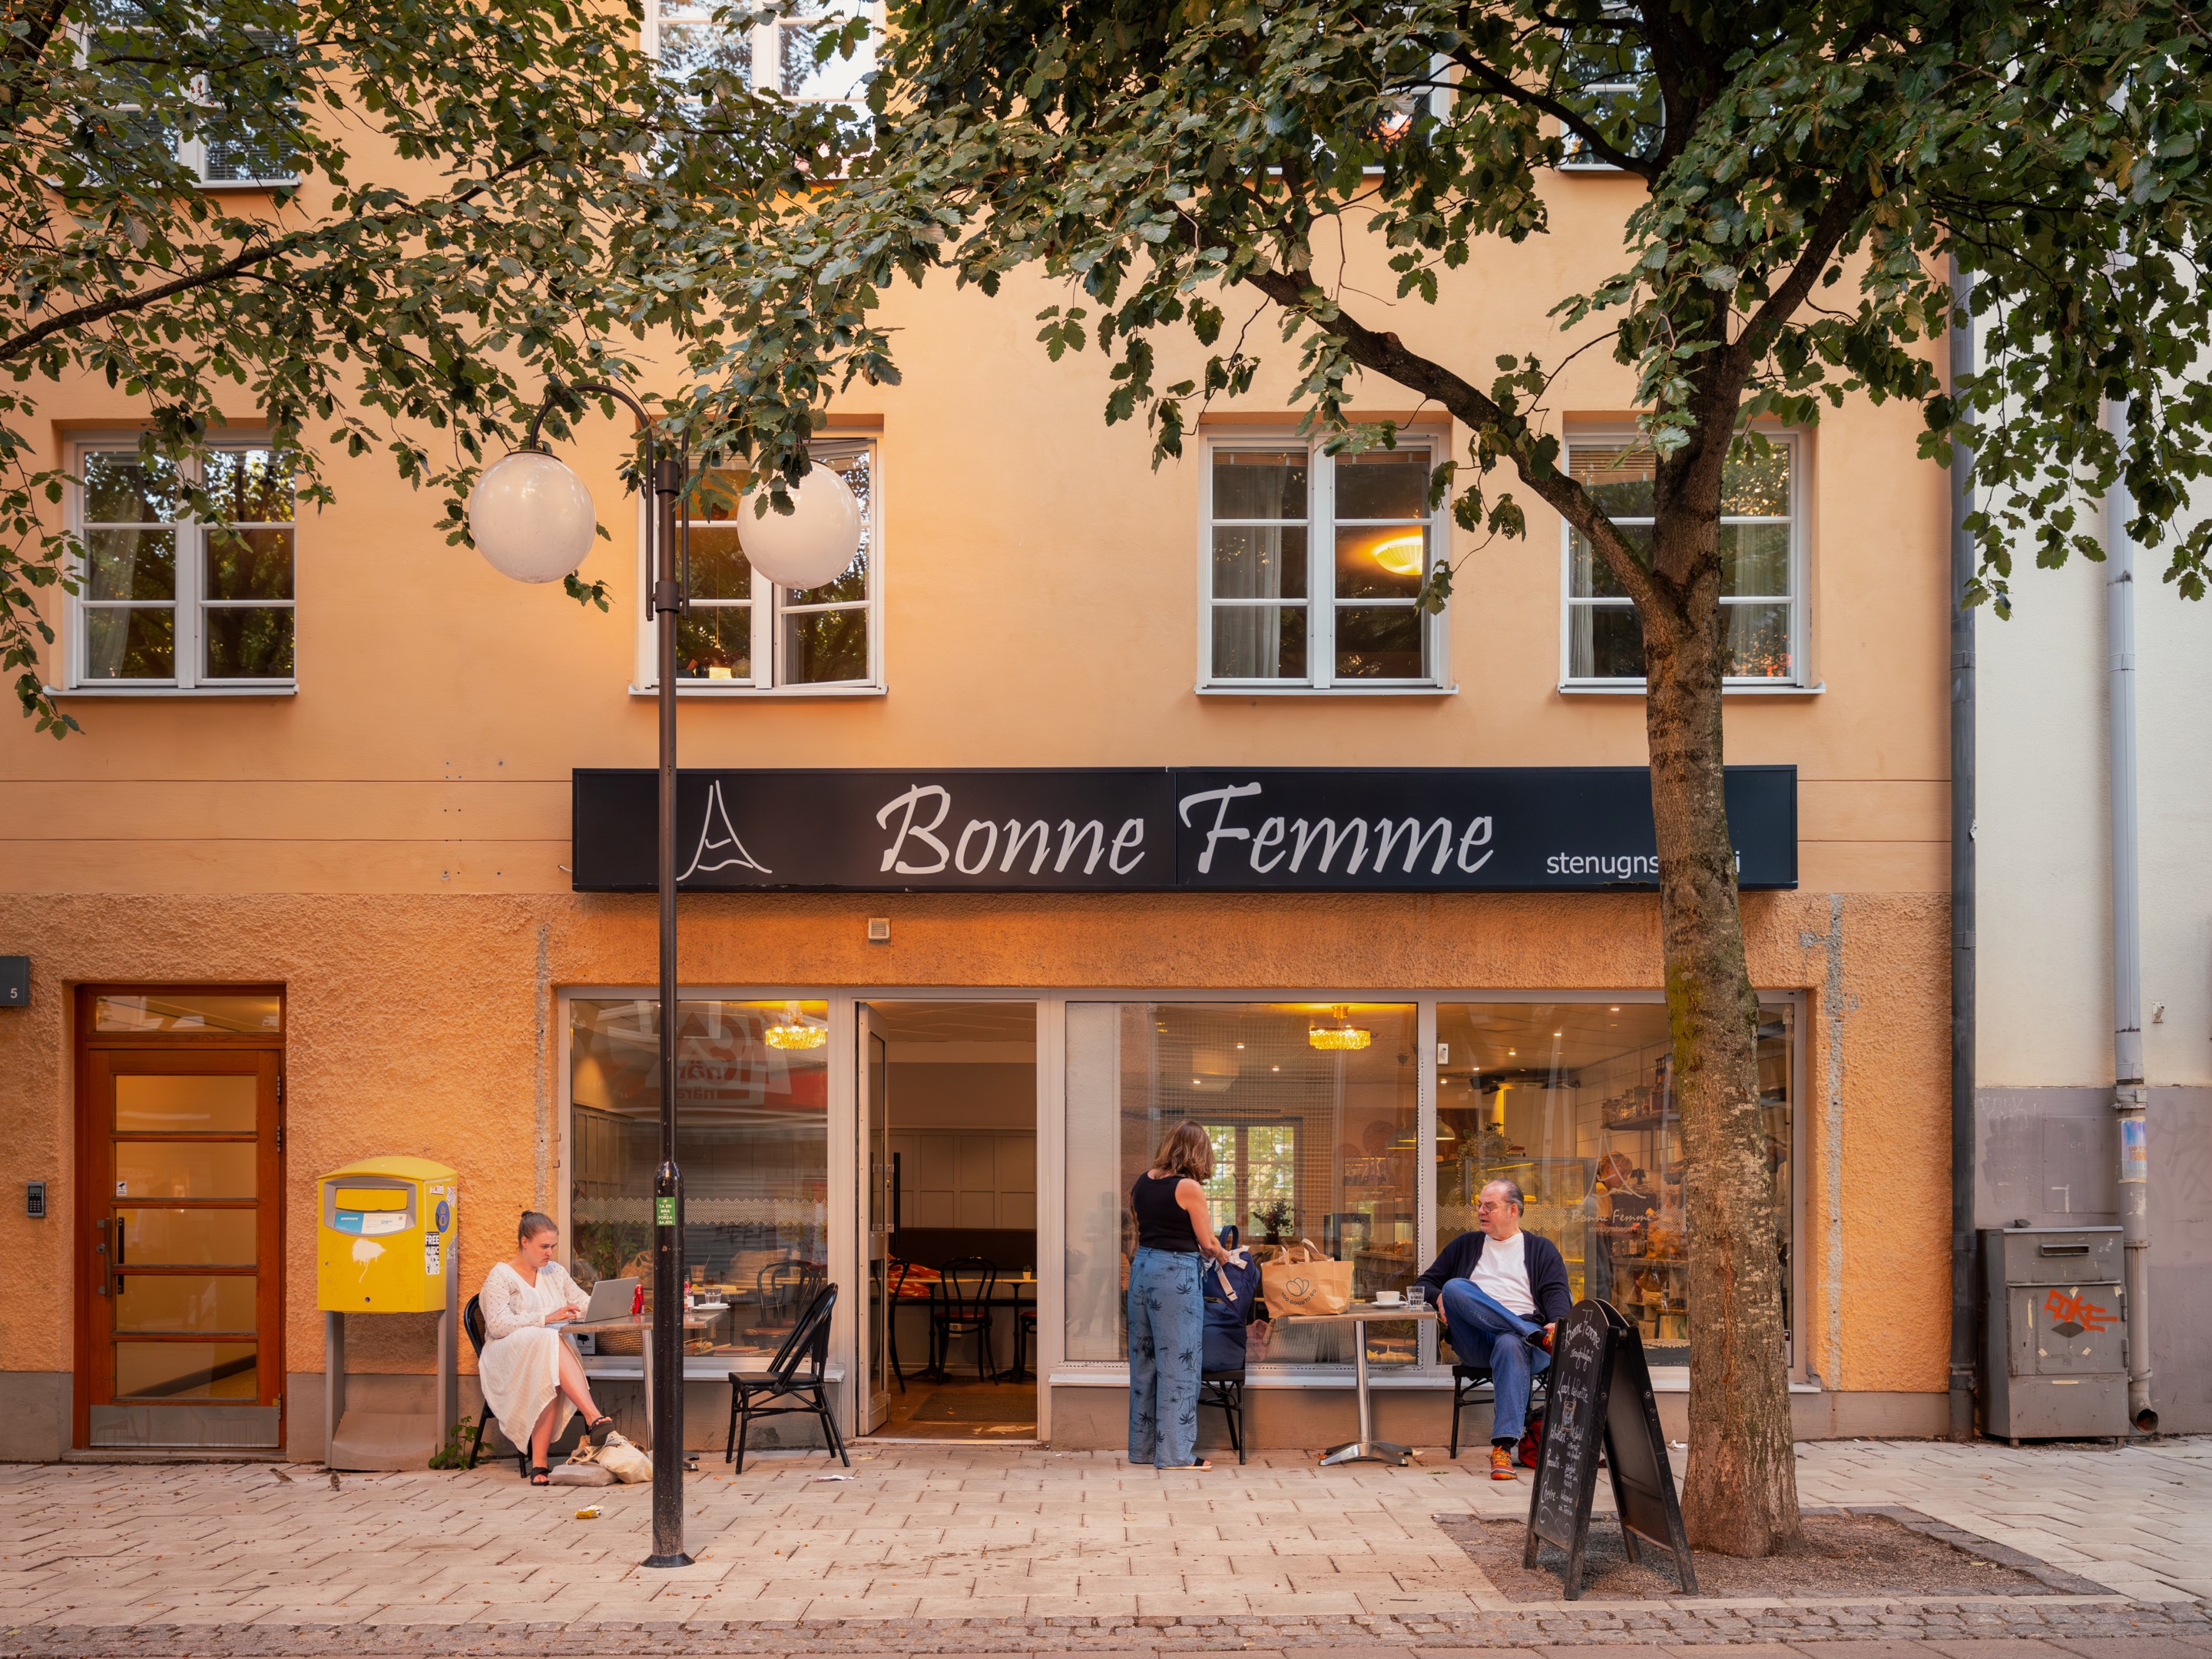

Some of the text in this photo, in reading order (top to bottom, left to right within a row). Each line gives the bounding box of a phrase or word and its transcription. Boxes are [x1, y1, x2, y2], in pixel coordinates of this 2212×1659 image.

[876, 781, 1494, 876] Bonne Femme
[1546, 851, 1740, 879] stenugnsi
[10, 987, 18, 999] 5
[1571, 1208, 1652, 1224] Bonne Femme
[425, 1234, 440, 1245] FREE
[1281, 1292, 1290, 1302] TOO
[1310, 1289, 1316, 1297] GO
